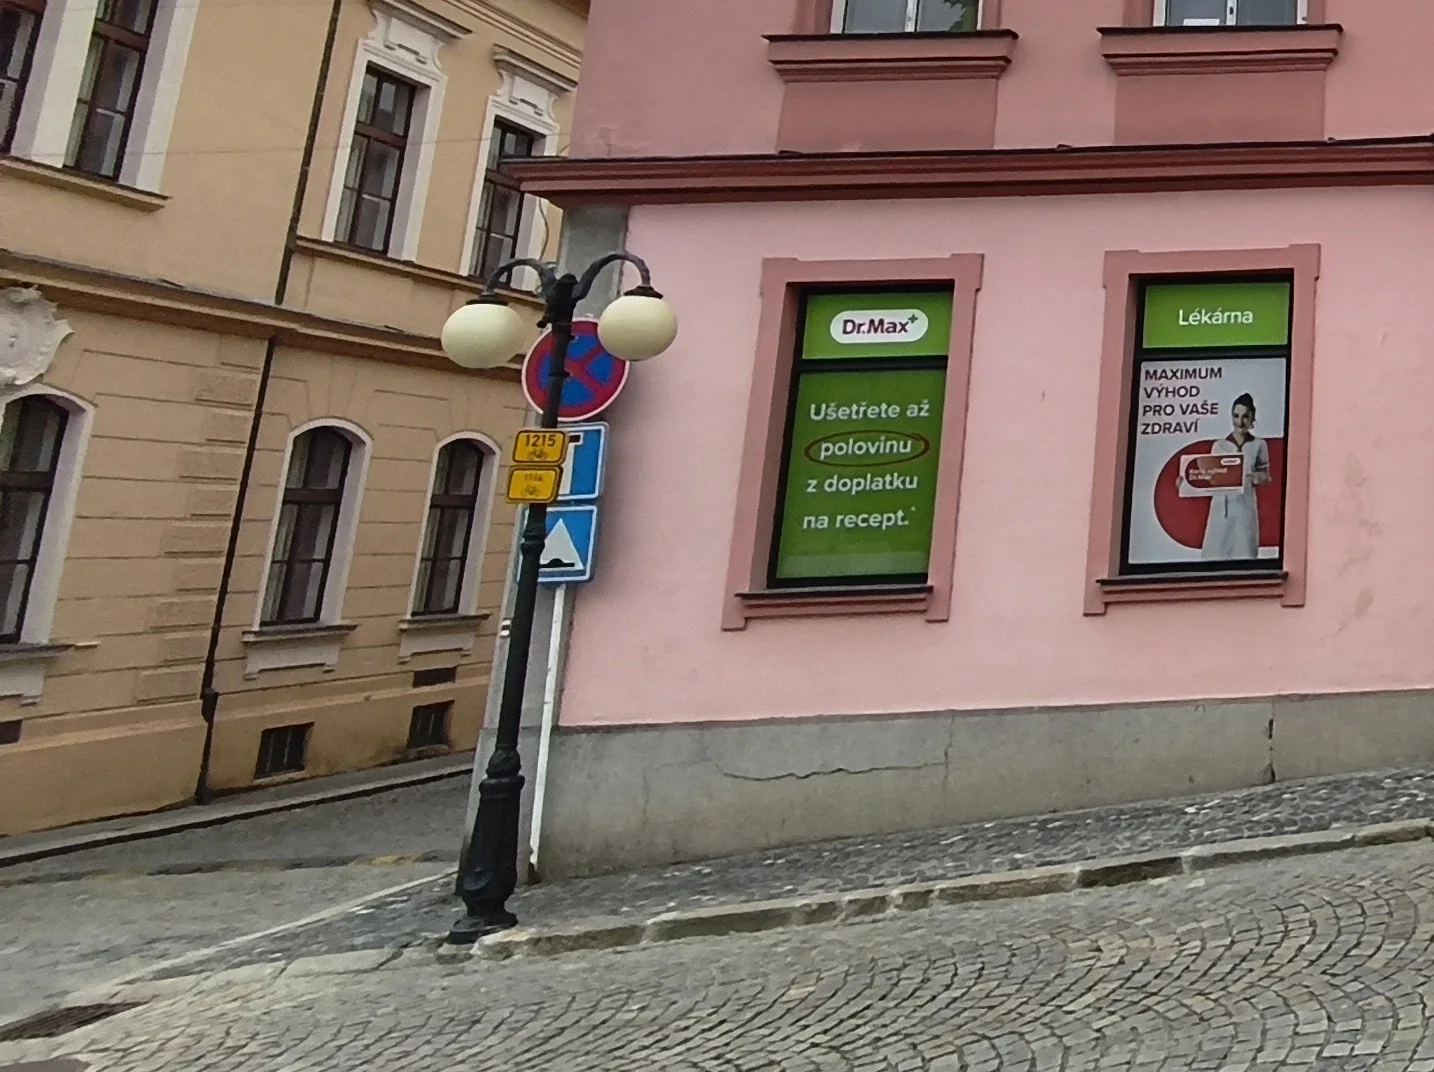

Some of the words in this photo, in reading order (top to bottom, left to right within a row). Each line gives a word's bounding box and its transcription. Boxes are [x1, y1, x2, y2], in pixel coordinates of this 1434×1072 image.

[1178, 308, 1254, 326] Lékárna
[1144, 366, 1223, 381] MAXIMUM
[1143, 383, 1200, 399] VÝHOD
[809, 401, 901, 421] Ušetřete
[906, 399, 930, 418] až
[1142, 403, 1175, 417] PRO
[1179, 400, 1219, 416] VAŠE
[1141, 418, 1200, 436] ZDRAVÍ
[525, 434, 557, 447] 1215
[819, 436, 912, 460] polovinu
[806, 478, 817, 493] z
[823, 473, 918, 495] doplatku
[803, 514, 828, 529] na
